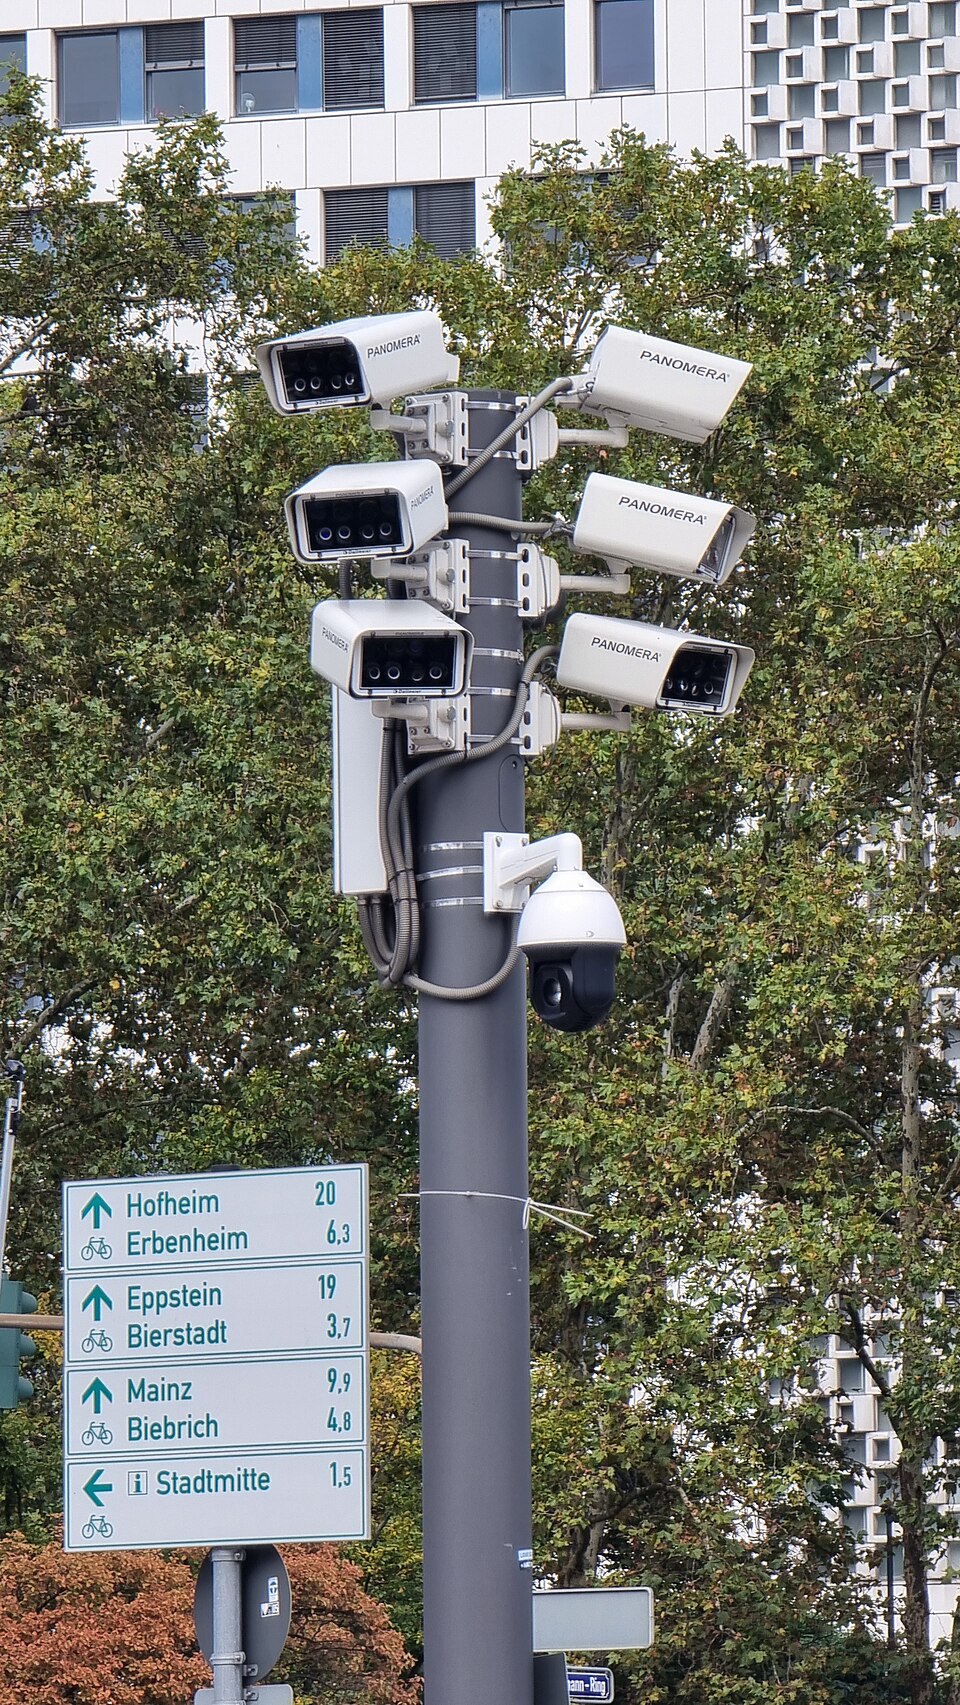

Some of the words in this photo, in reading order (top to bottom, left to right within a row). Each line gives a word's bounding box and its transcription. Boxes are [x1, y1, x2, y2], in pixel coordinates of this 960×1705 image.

[127, 1189, 219, 1217] Hofheim
[315, 1181, 335, 1206] 20
[127, 1226, 248, 1255] Erbenheim
[327, 1219, 350, 1245] 6,3
[128, 1281, 222, 1316] Eppstein
[318, 1274, 336, 1299] 19
[128, 1319, 227, 1348] Bierstadt
[327, 1313, 350, 1339] 3,7
[128, 1377, 192, 1403] Mainz
[327, 1367, 350, 1394] 9,9
[128, 1413, 218, 1441] Biebrich
[327, 1407, 351, 1432] 4,8
[156, 1467, 270, 1495] Stadtmitte
[329, 1461, 351, 1487] 1,5
